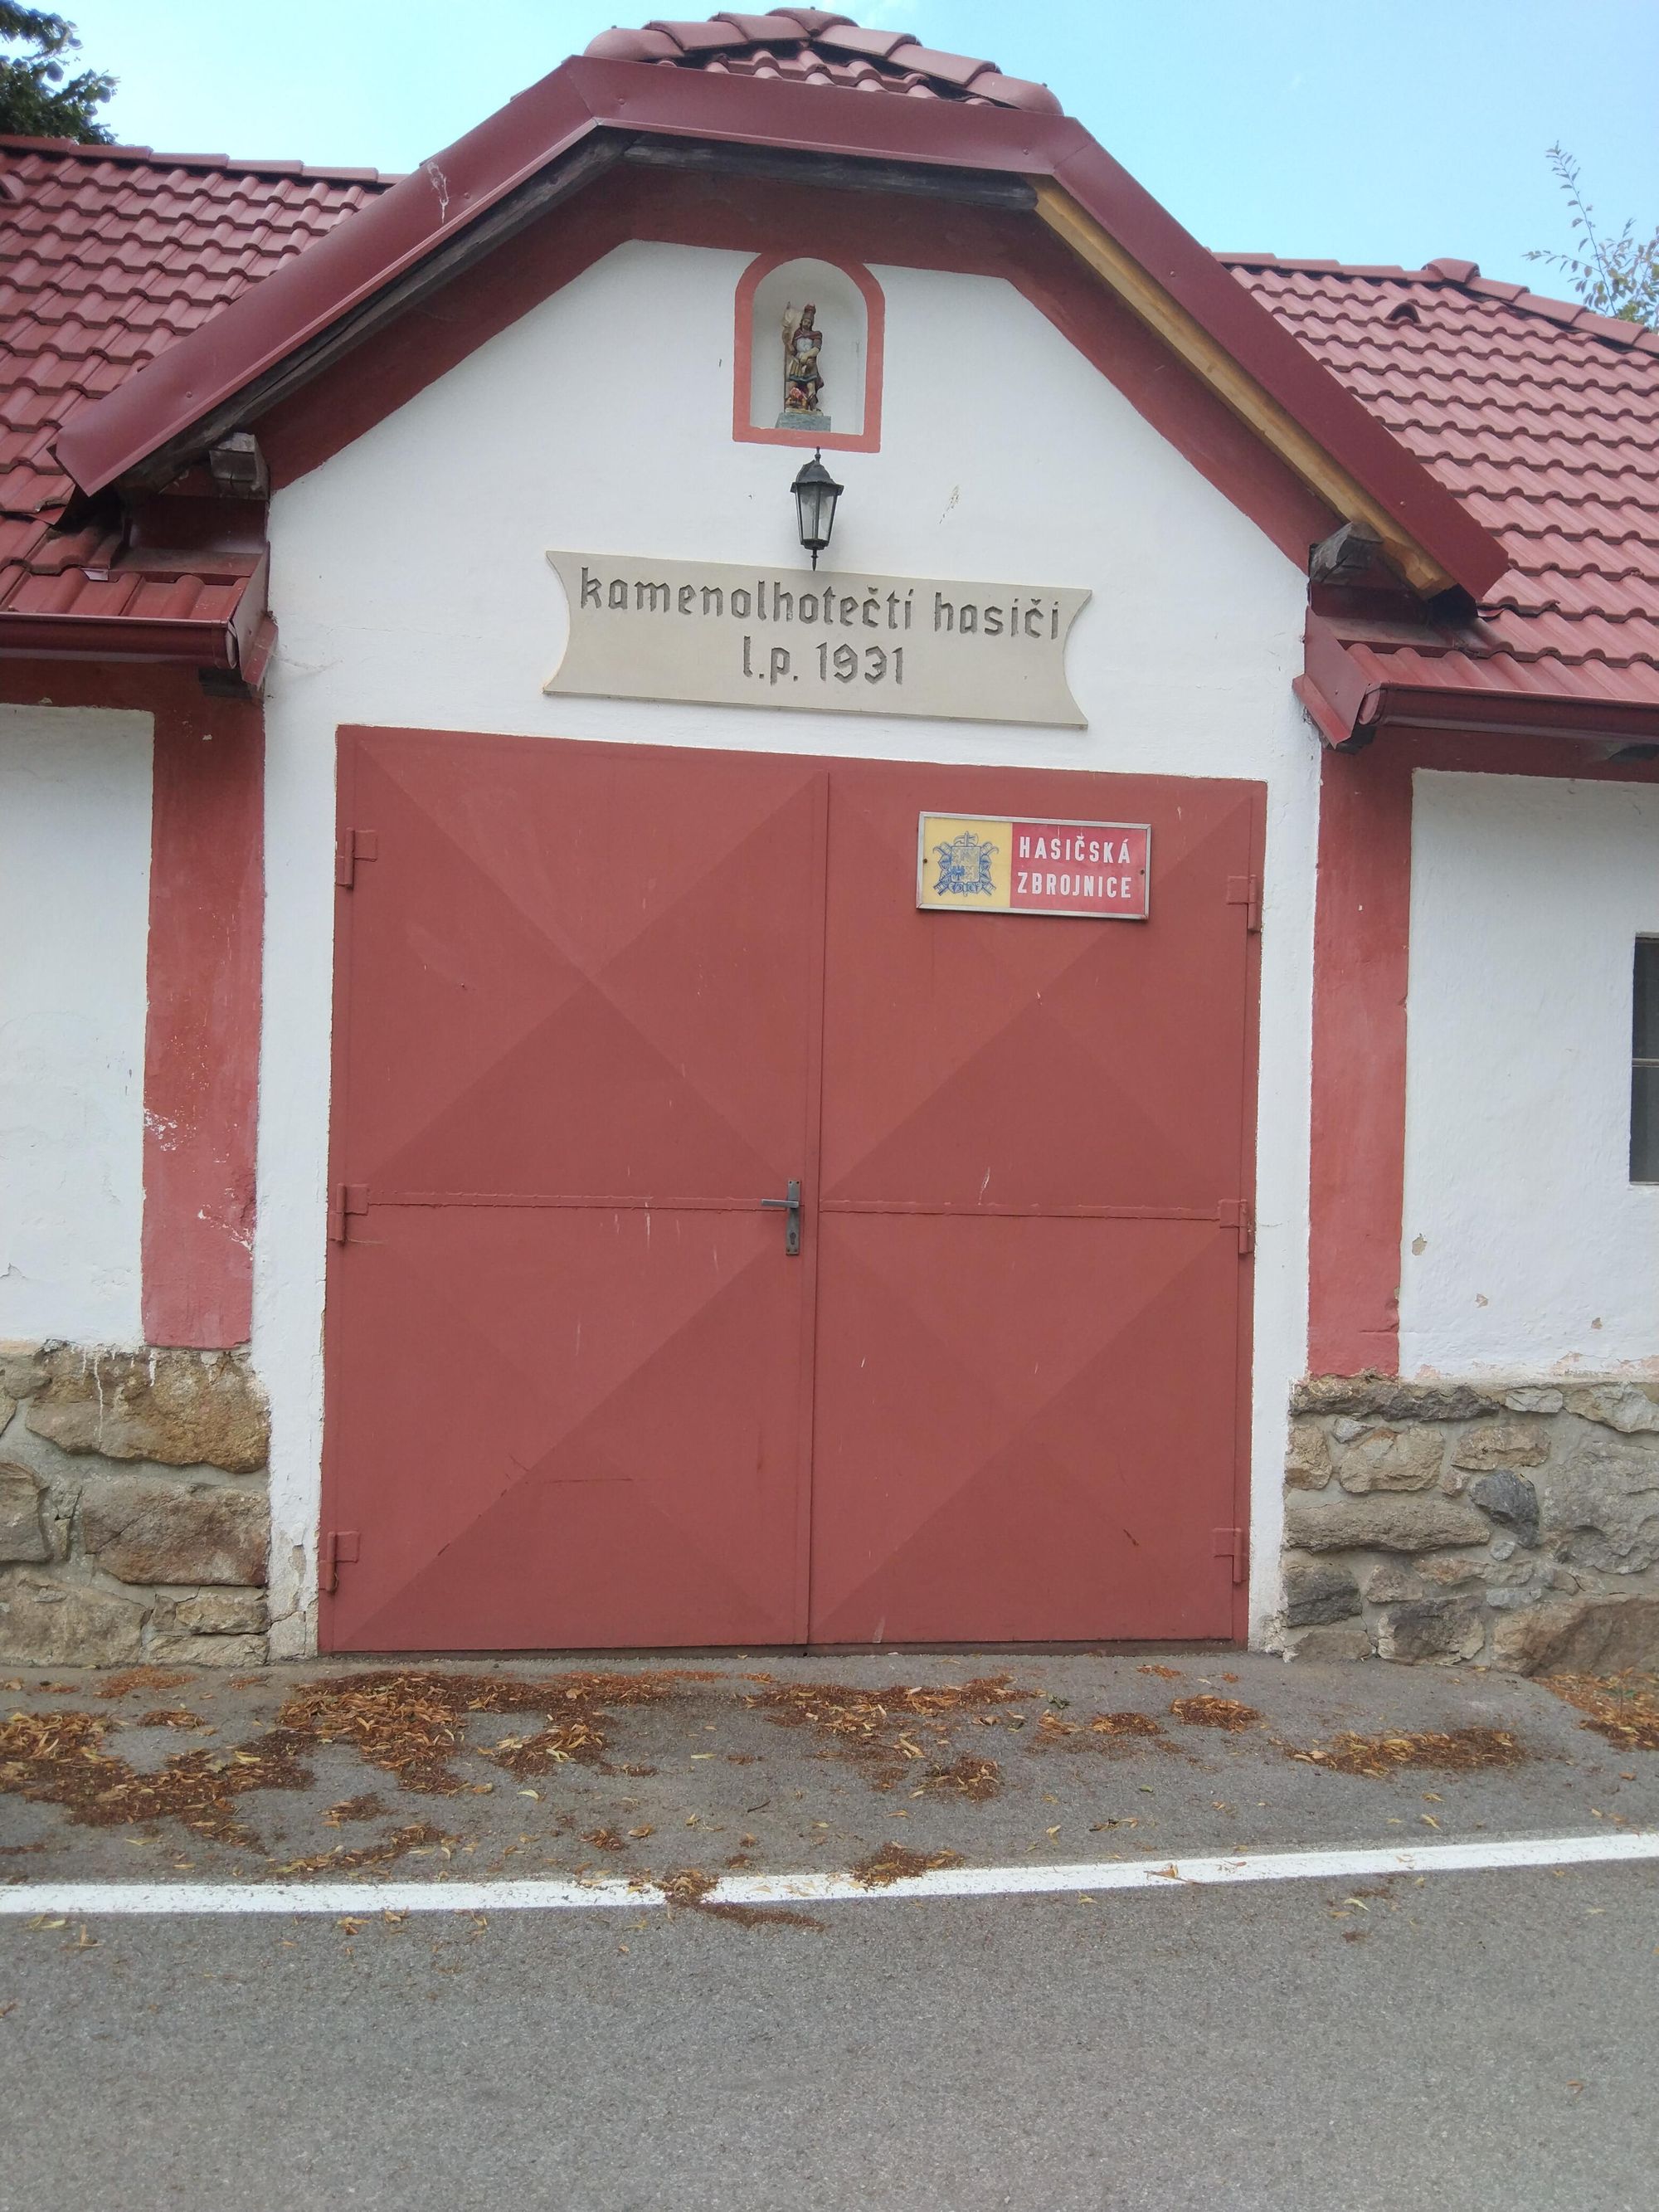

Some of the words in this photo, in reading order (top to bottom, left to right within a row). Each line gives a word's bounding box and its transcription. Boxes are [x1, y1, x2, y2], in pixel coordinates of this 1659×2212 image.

[743, 636, 799, 685] l.p.
[816, 641, 903, 685] 1931
[1019, 836, 1130, 864] HASIČSKÁ
[1017, 872, 1131, 899] ZBROJNICE
